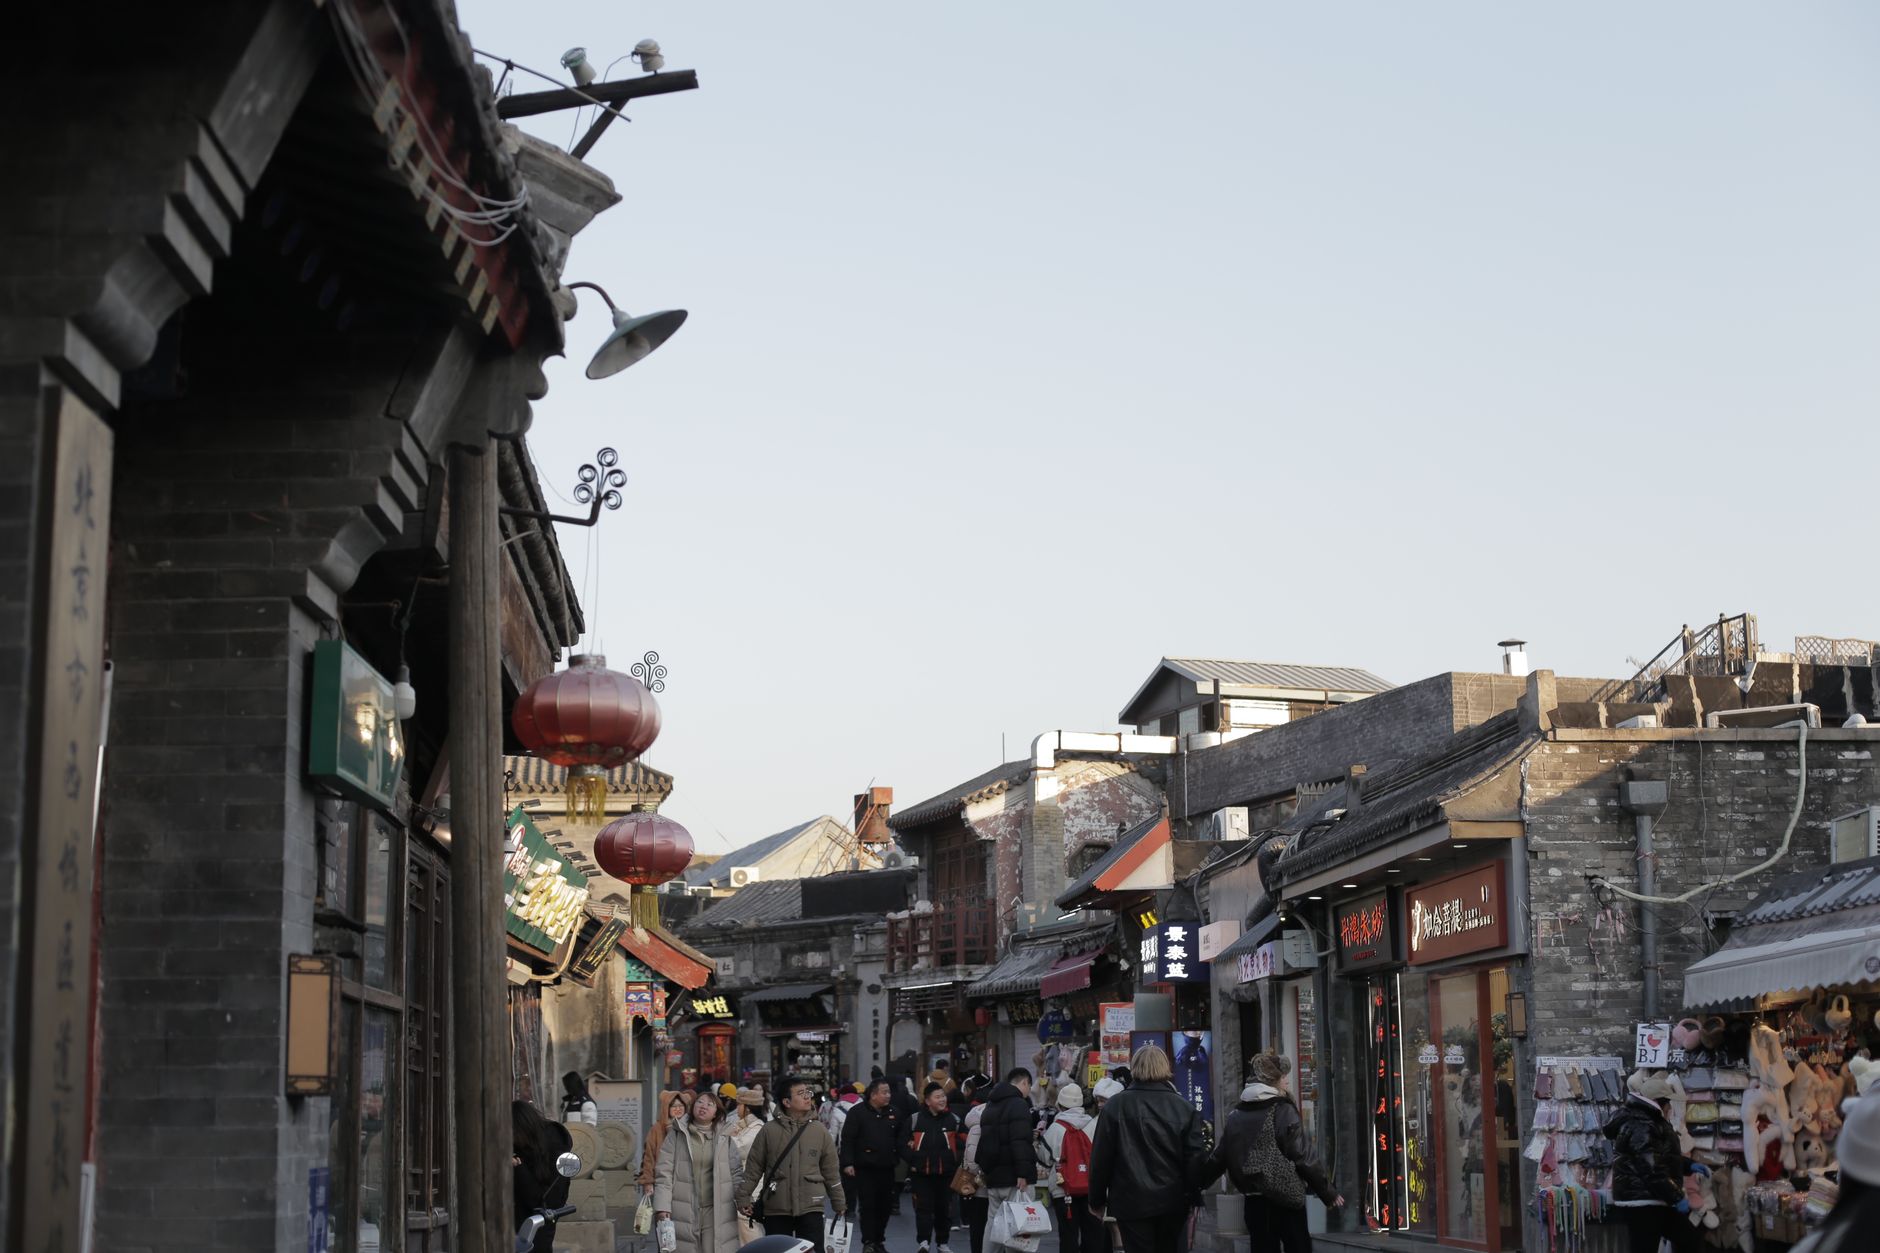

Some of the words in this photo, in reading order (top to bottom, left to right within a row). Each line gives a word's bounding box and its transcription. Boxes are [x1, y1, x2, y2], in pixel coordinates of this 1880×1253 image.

[1164, 926, 1188, 978] 景泰蓝
[1639, 1034, 1646, 1046] I
[1638, 1048, 1660, 1063] BJ
